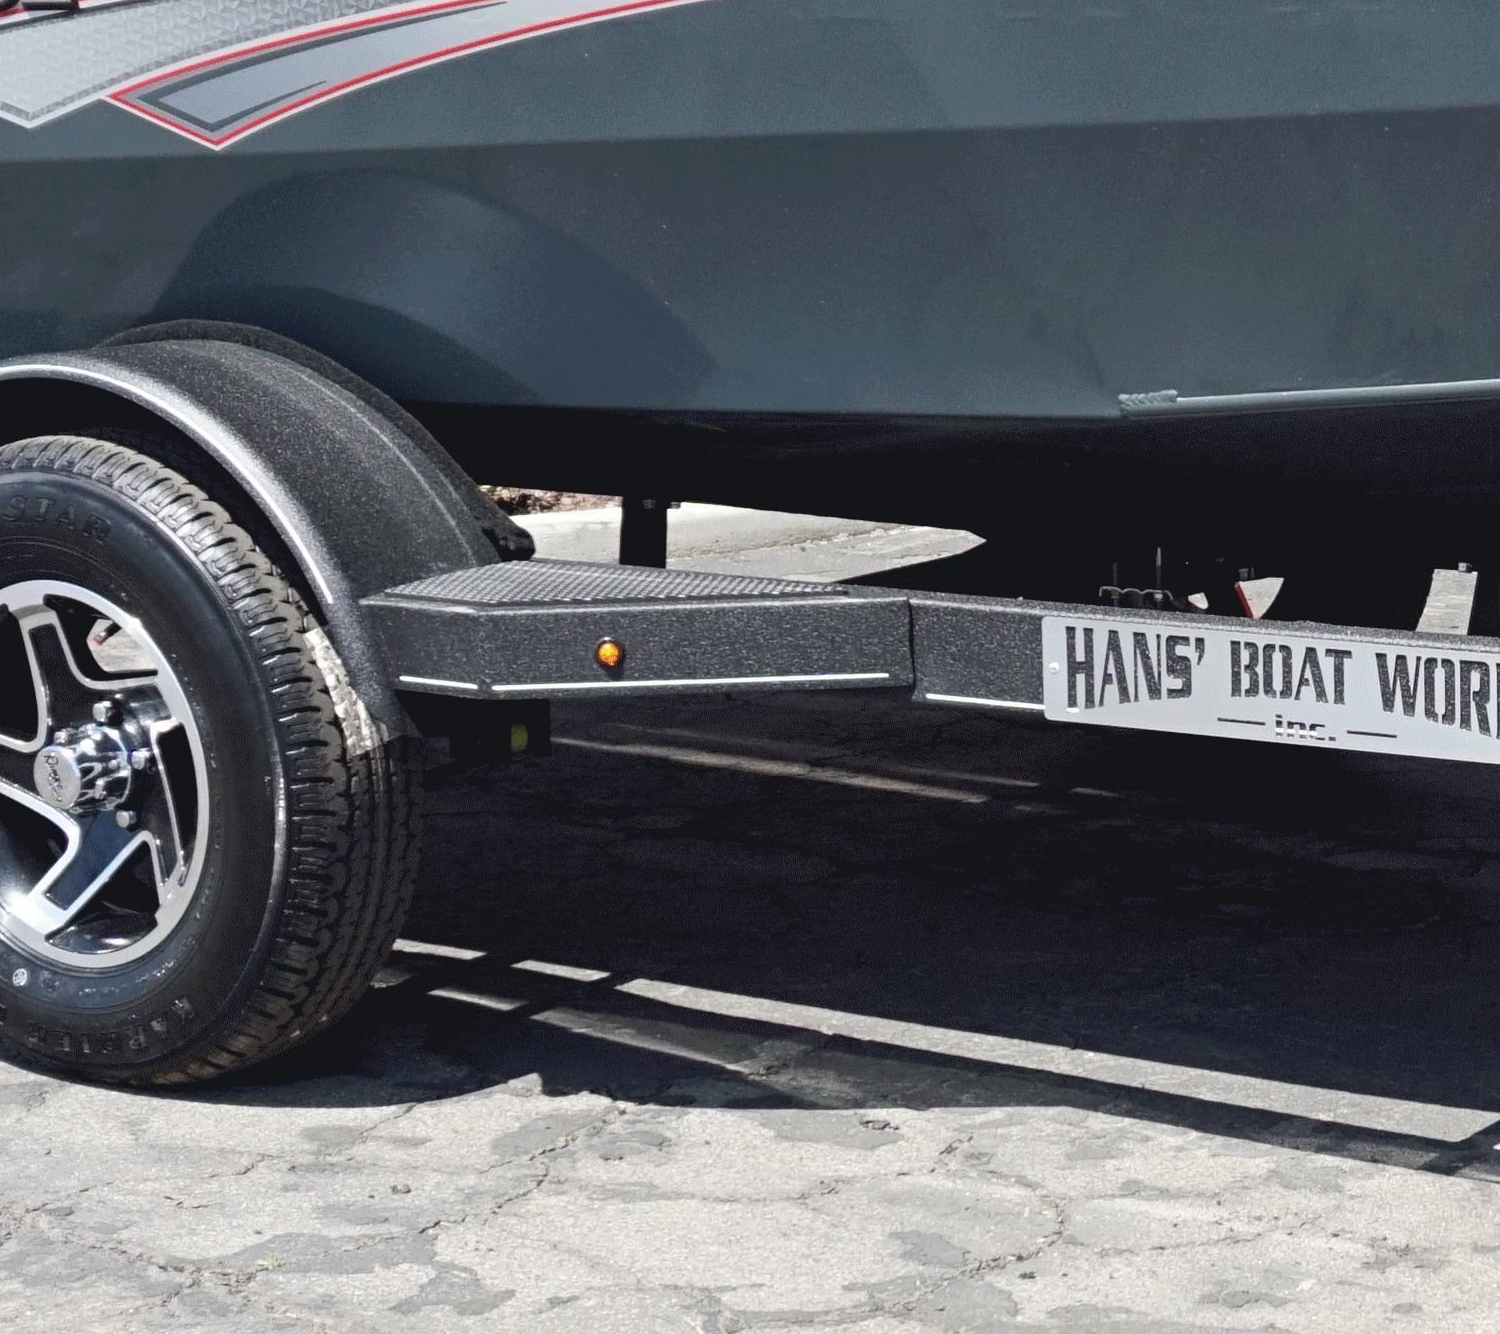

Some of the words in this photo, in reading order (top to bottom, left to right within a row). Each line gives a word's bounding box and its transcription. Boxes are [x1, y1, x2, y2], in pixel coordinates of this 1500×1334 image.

[1, 493, 113, 546] STAR
[1064, 625, 1206, 710] HANS'
[1229, 640, 1353, 706] BOAT
[1274, 714, 1337, 741] inc.
